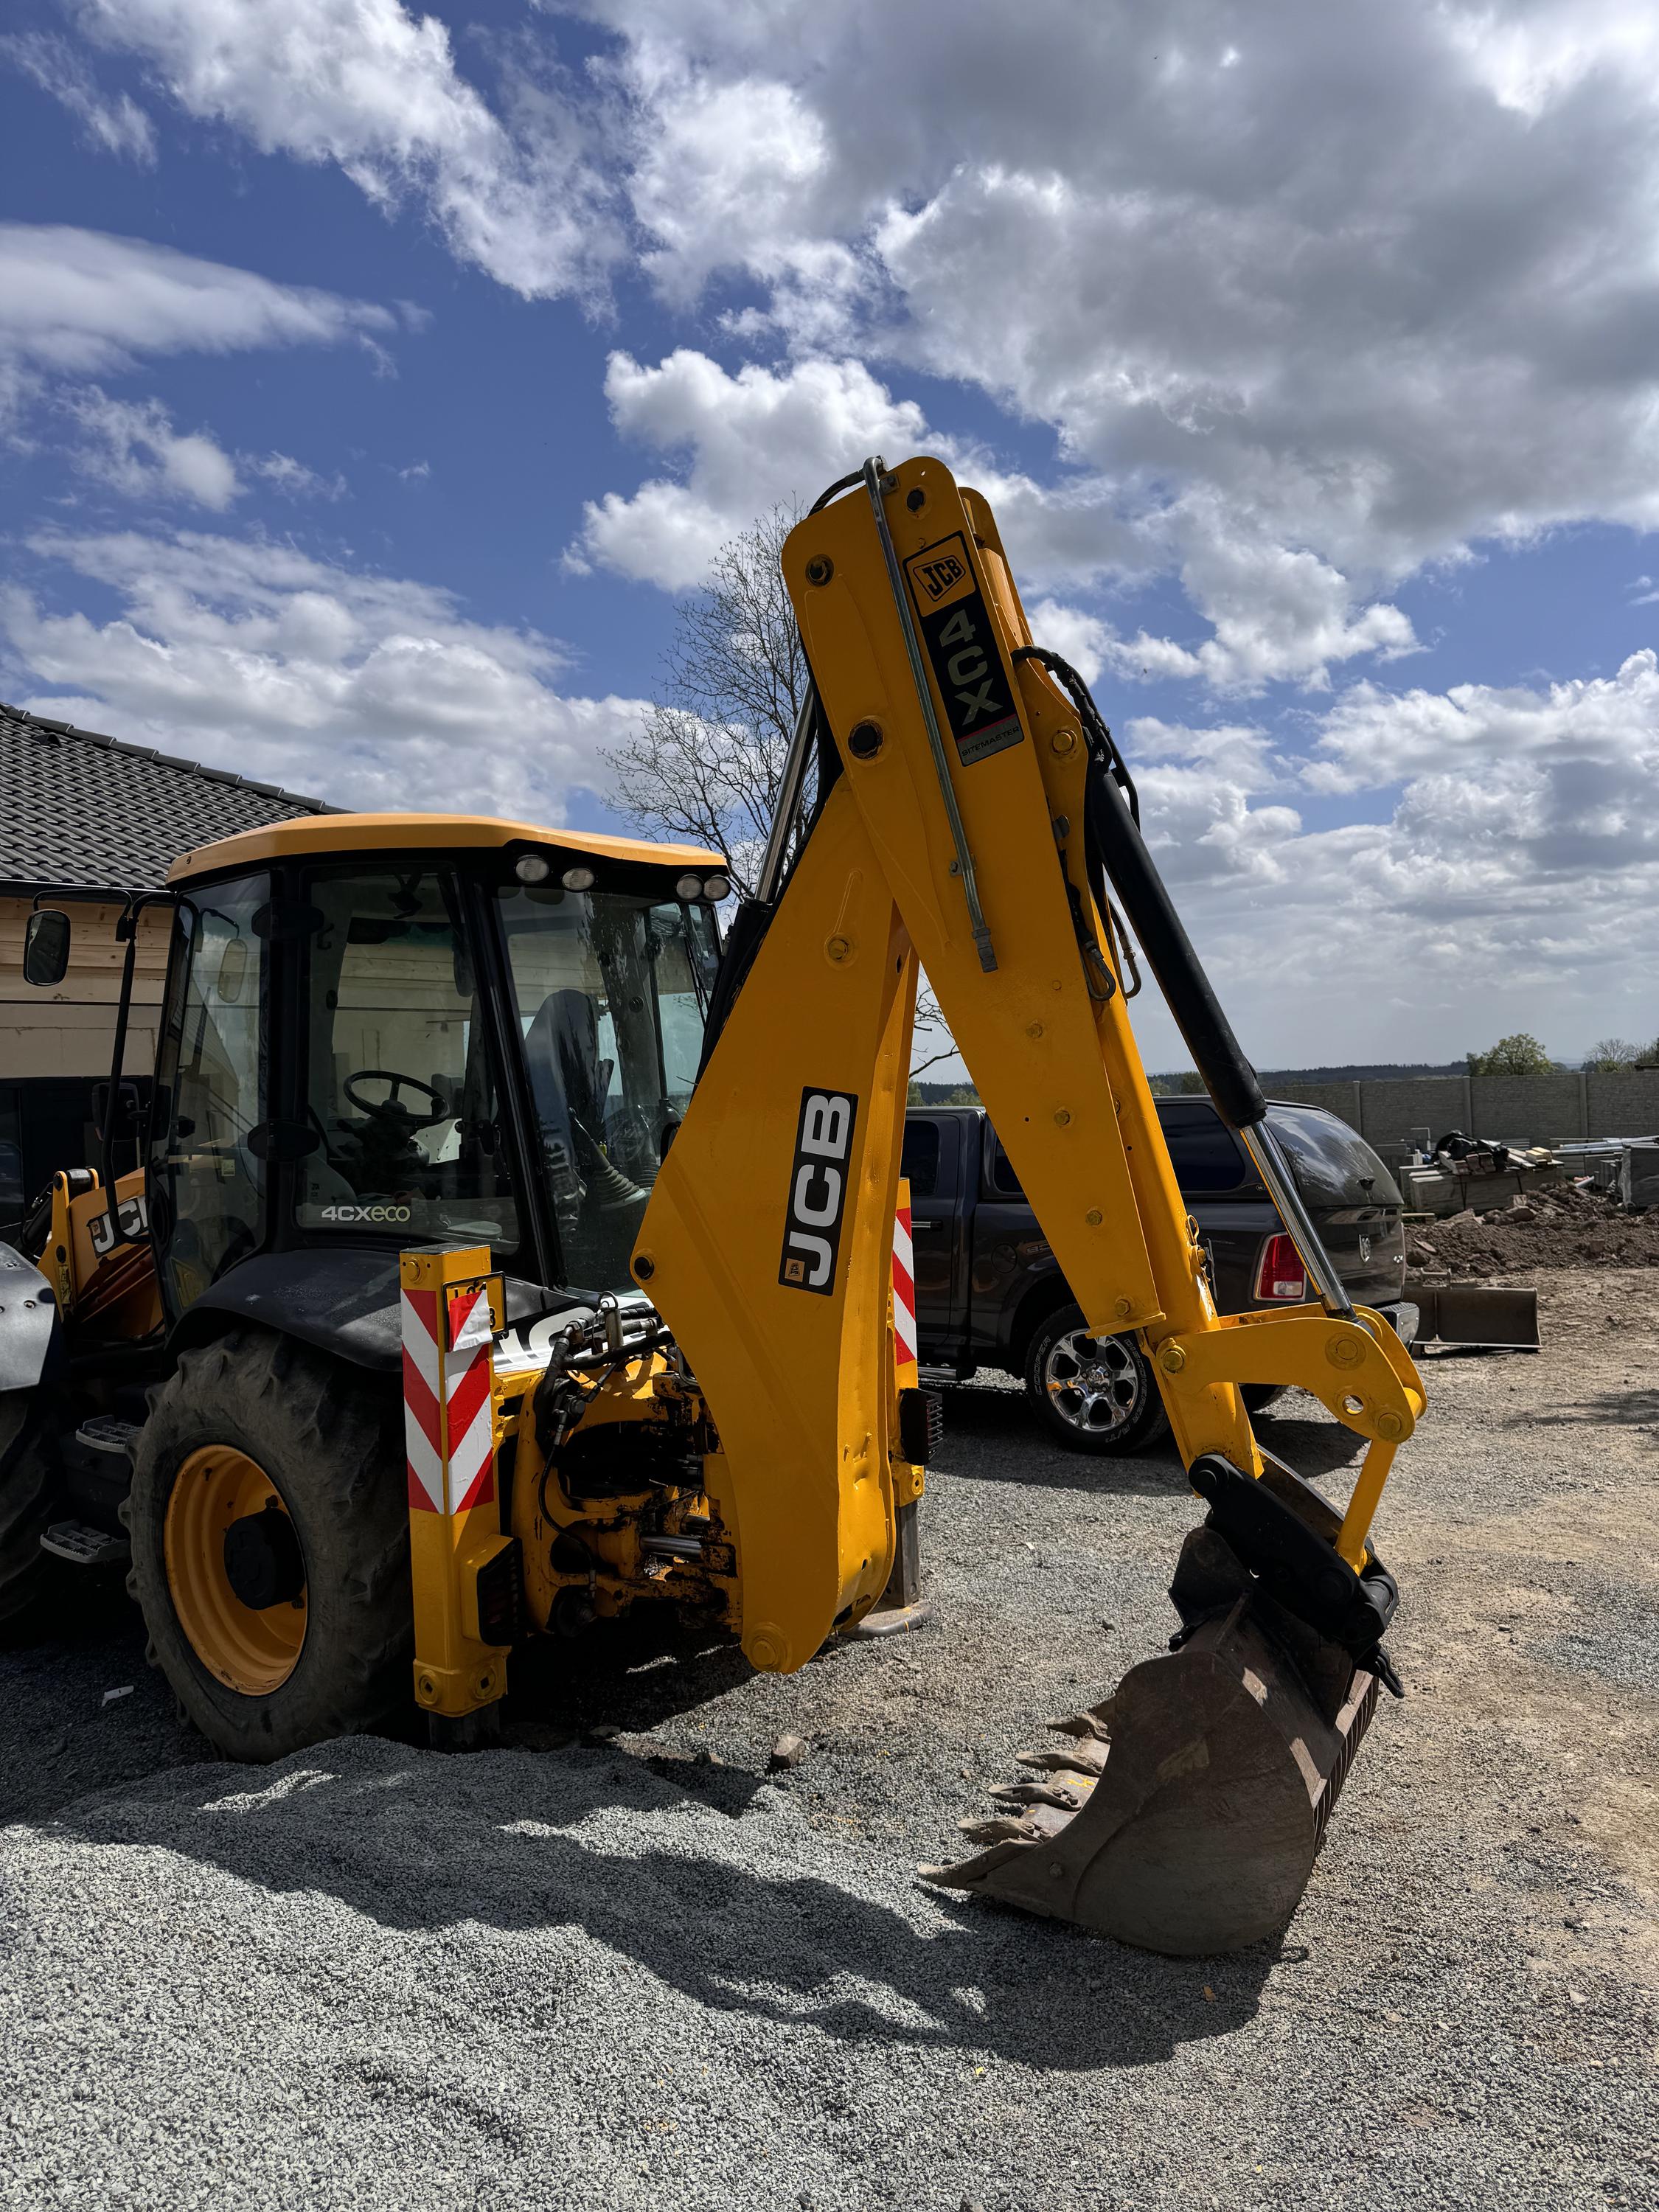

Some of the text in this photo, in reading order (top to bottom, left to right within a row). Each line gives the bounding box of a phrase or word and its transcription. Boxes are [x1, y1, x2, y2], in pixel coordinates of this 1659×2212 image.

[922, 558, 962, 597] JCB
[939, 608, 1003, 726] 4CX
[961, 726, 1020, 757] SITEMASTER
[788, 1094, 851, 1287] JCB
[1034, 1335, 1052, 1396] COOPER
[1124, 1338, 1148, 1425] DISCOVERER
